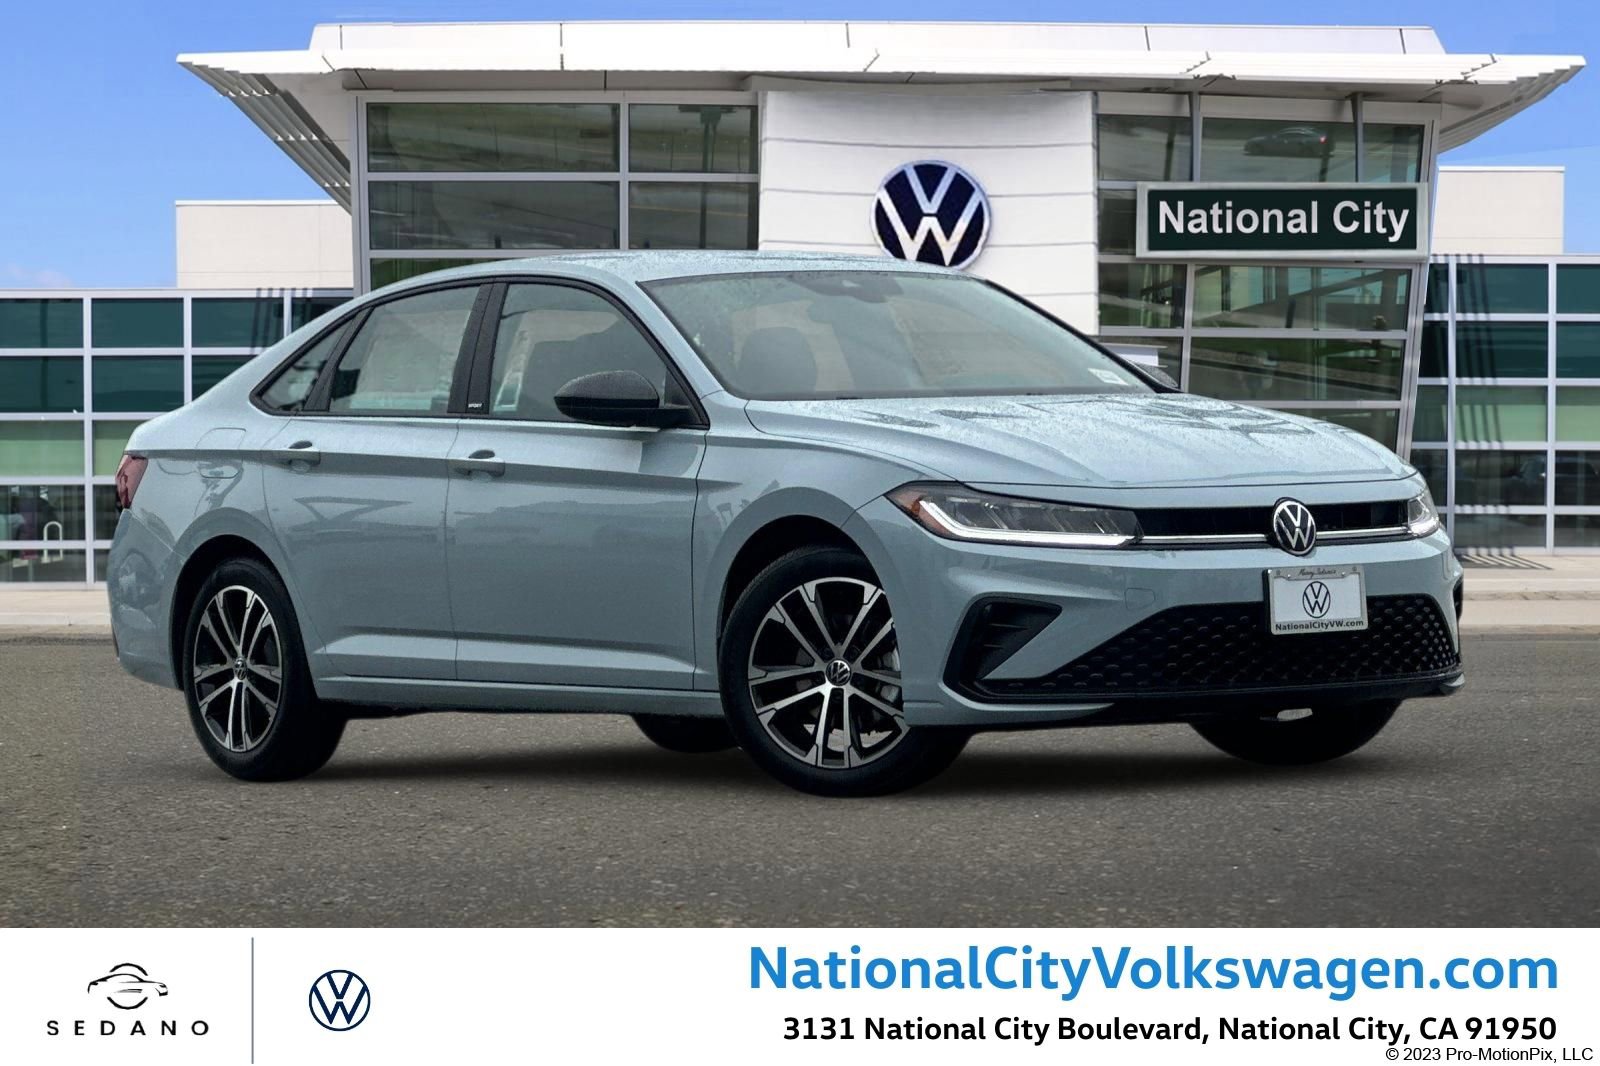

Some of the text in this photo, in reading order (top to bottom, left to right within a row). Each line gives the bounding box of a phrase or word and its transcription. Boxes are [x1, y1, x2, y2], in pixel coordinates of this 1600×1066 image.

[1158, 200, 1410, 243] National City
[1275, 620, 1364, 631] NationalCityVW.com
